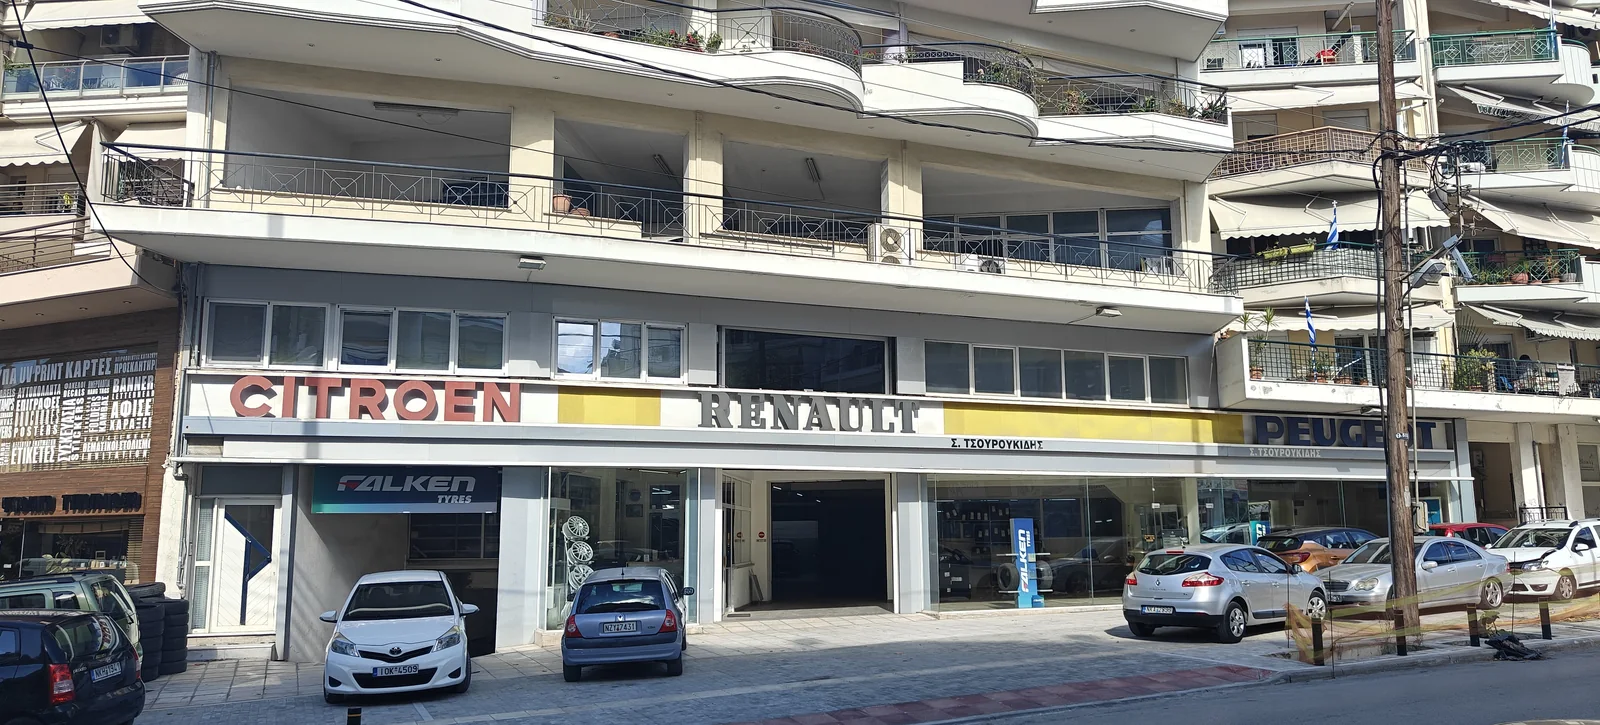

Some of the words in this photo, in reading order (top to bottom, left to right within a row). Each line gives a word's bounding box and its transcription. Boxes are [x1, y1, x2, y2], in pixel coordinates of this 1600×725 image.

[20, 366, 33, 383] UV
[34, 362, 64, 382] PRINT
[65, 357, 112, 379] ΚΑΡΤΕΣ
[16, 396, 61, 411] ΕΠΙΓΡΑΦΕΣ
[229, 375, 521, 422] CITROEN
[89, 395, 101, 432] FOLDERS
[697, 391, 920, 433] RENAULT
[13, 423, 58, 438] POSTERS
[57, 398, 76, 462] ΣΥΣΚΕΥΑΣΙΑ
[70, 397, 84, 461] STICKERS
[1254, 415, 1436, 449] PEUGET
[950, 438, 961, 448] Σ.
[964, 438, 1043, 450] ΤΣΟΥΡΟΥΚΙΔΗΣ
[11, 446, 56, 465] ΕΤΙΚΕΤΕΣ
[336, 475, 476, 492] FALKEN
[437, 495, 472, 504] TYRES
[1018, 529, 1029, 593] FALKEN
